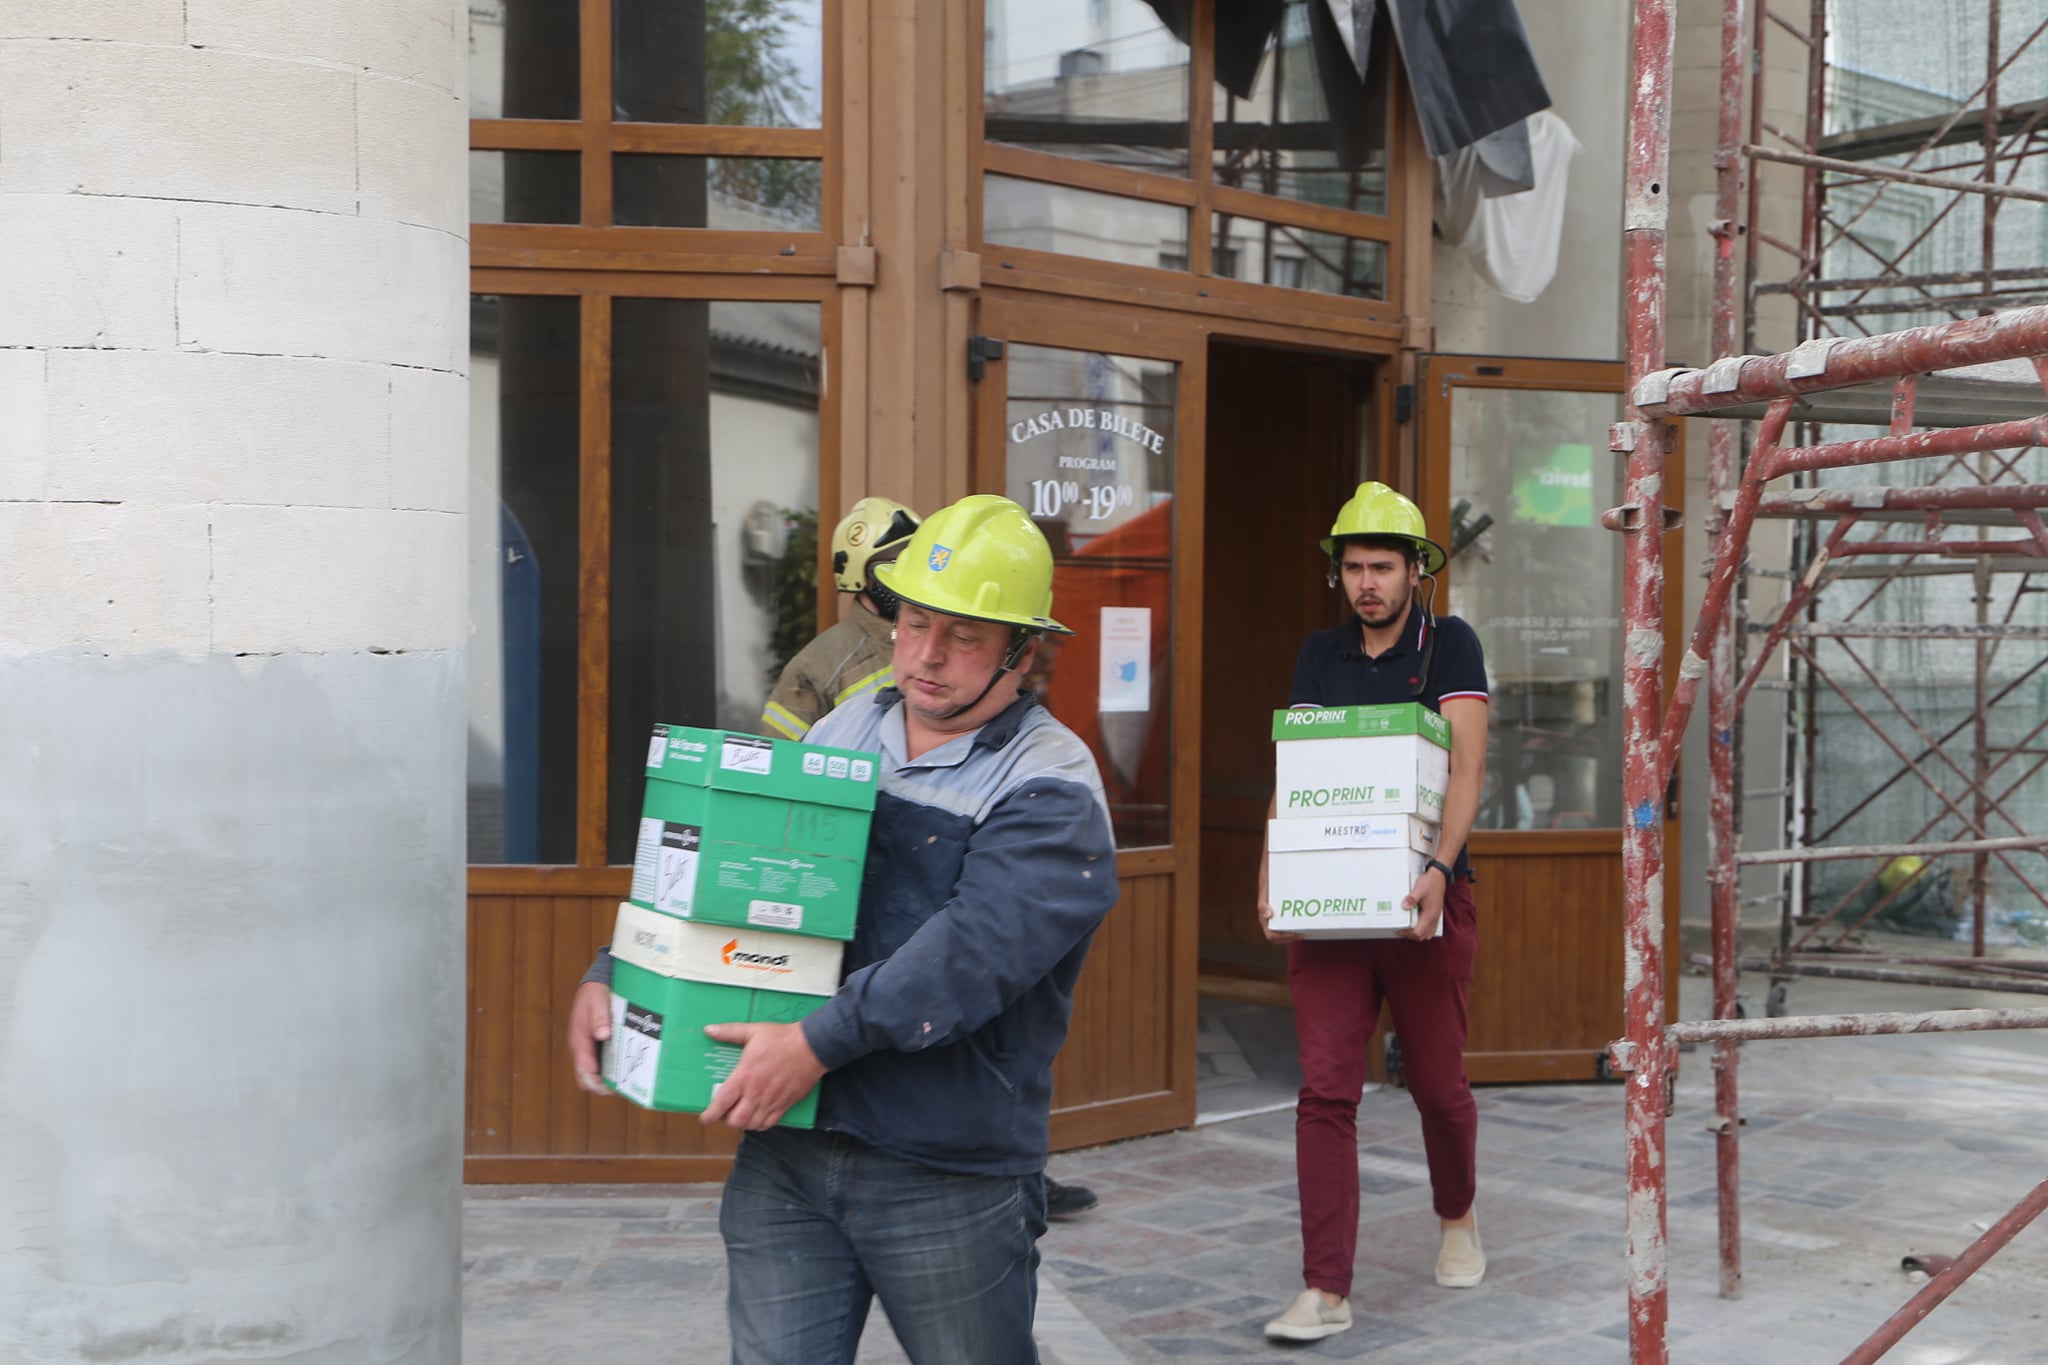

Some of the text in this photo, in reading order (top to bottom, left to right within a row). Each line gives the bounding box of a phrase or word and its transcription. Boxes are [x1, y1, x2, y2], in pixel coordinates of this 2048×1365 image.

[1011, 408, 1165, 454] CASA DE BILETE
[1058, 455, 1117, 471] PROGRAM
[852, 525, 862, 542] 2
[1324, 825, 1367, 836] MAESTRO
[734, 952, 791, 966] mondi
